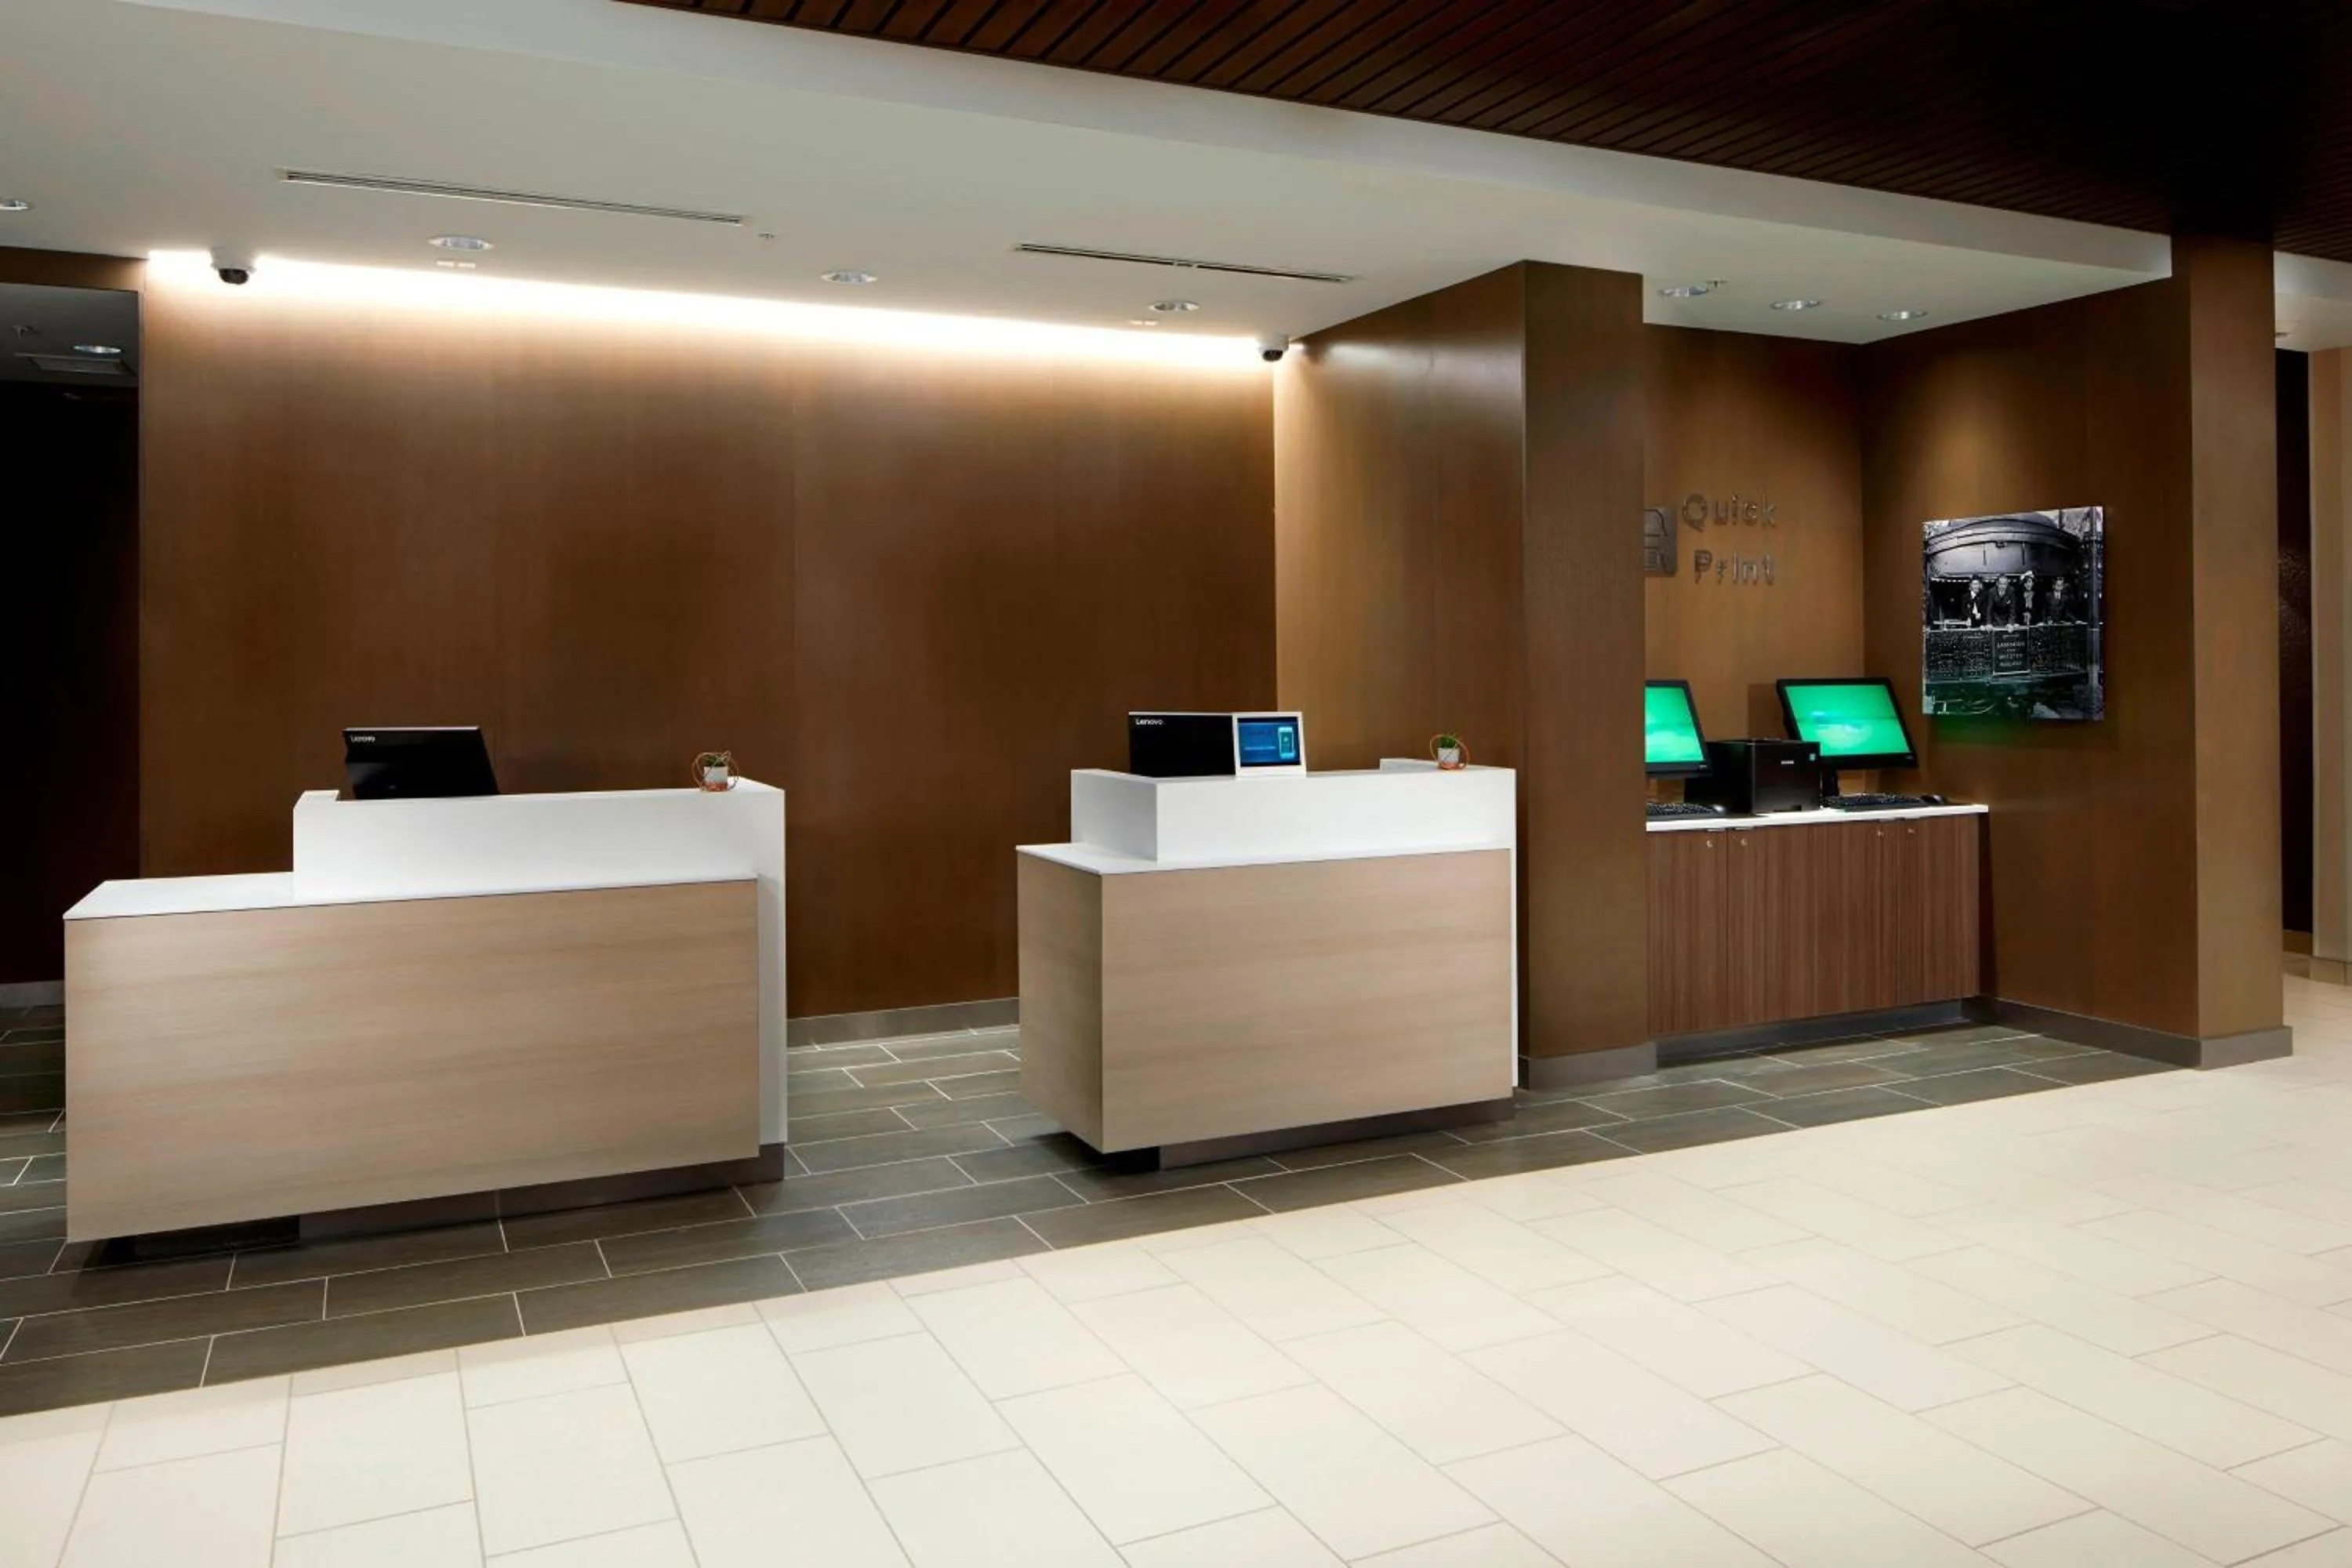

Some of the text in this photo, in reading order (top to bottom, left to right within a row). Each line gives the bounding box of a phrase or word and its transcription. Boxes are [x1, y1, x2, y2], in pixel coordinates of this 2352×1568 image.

[1682, 492, 1778, 532] Quick
[1693, 549, 1777, 586] Print
[1135, 717, 1164, 726] Lenovo
